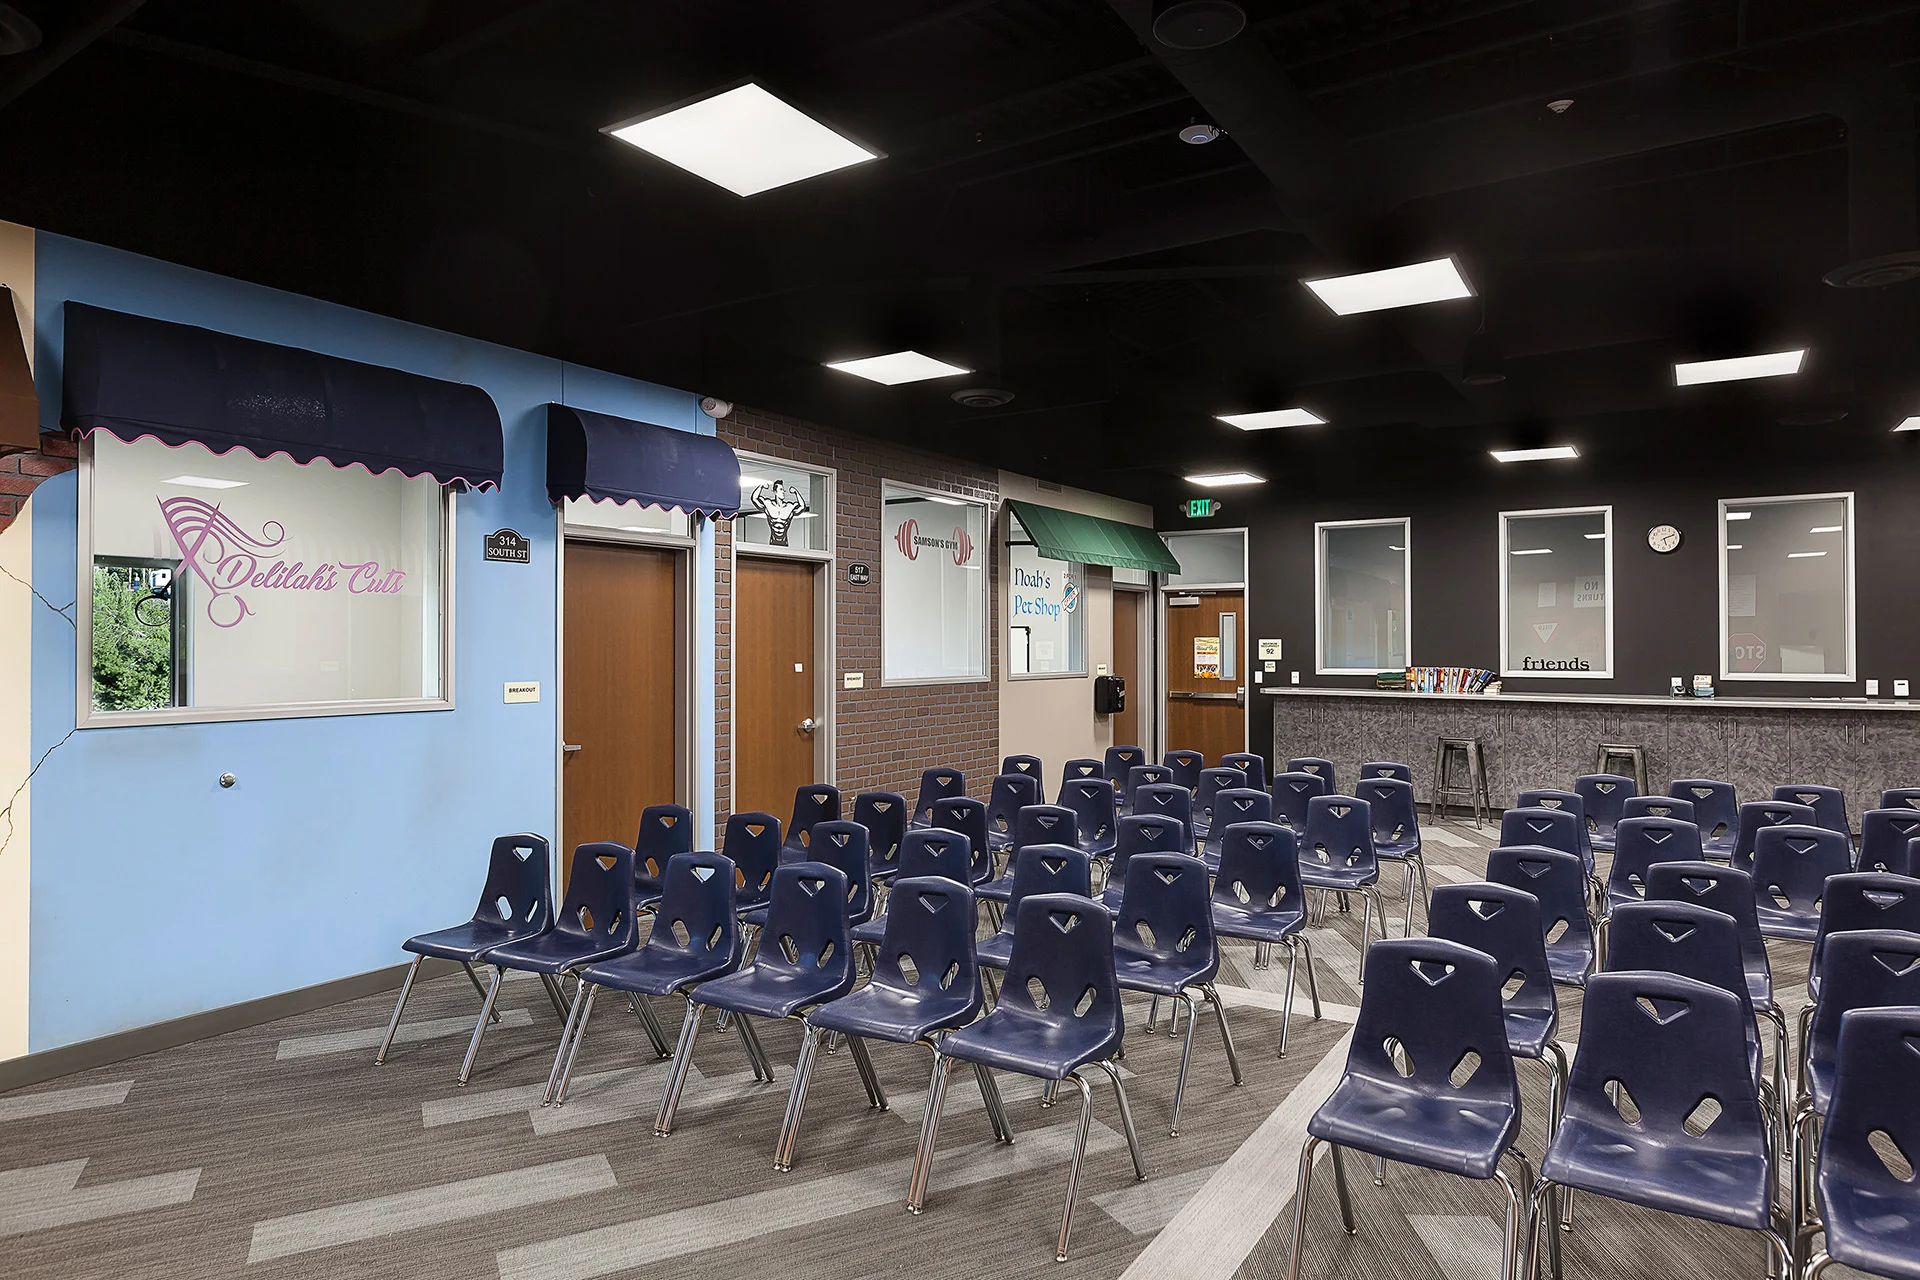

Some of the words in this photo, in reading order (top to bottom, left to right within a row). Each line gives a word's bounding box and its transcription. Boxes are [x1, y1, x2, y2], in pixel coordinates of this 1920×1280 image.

[1191, 499, 1210, 516] EXIT
[499, 535, 517, 547] 314
[913, 535, 945, 549] SAMSON'S
[945, 540, 958, 550] GYM
[488, 547, 516, 558] SOUTH
[517, 549, 527, 559] ST
[212, 554, 339, 591] Delilah's
[338, 560, 407, 594] Cuts
[854, 566, 864, 574] 517
[1014, 567, 1051, 589] Noah's
[1013, 595, 1033, 618] Pet
[1035, 597, 1061, 622] Shop
[1522, 656, 1590, 671] friends
